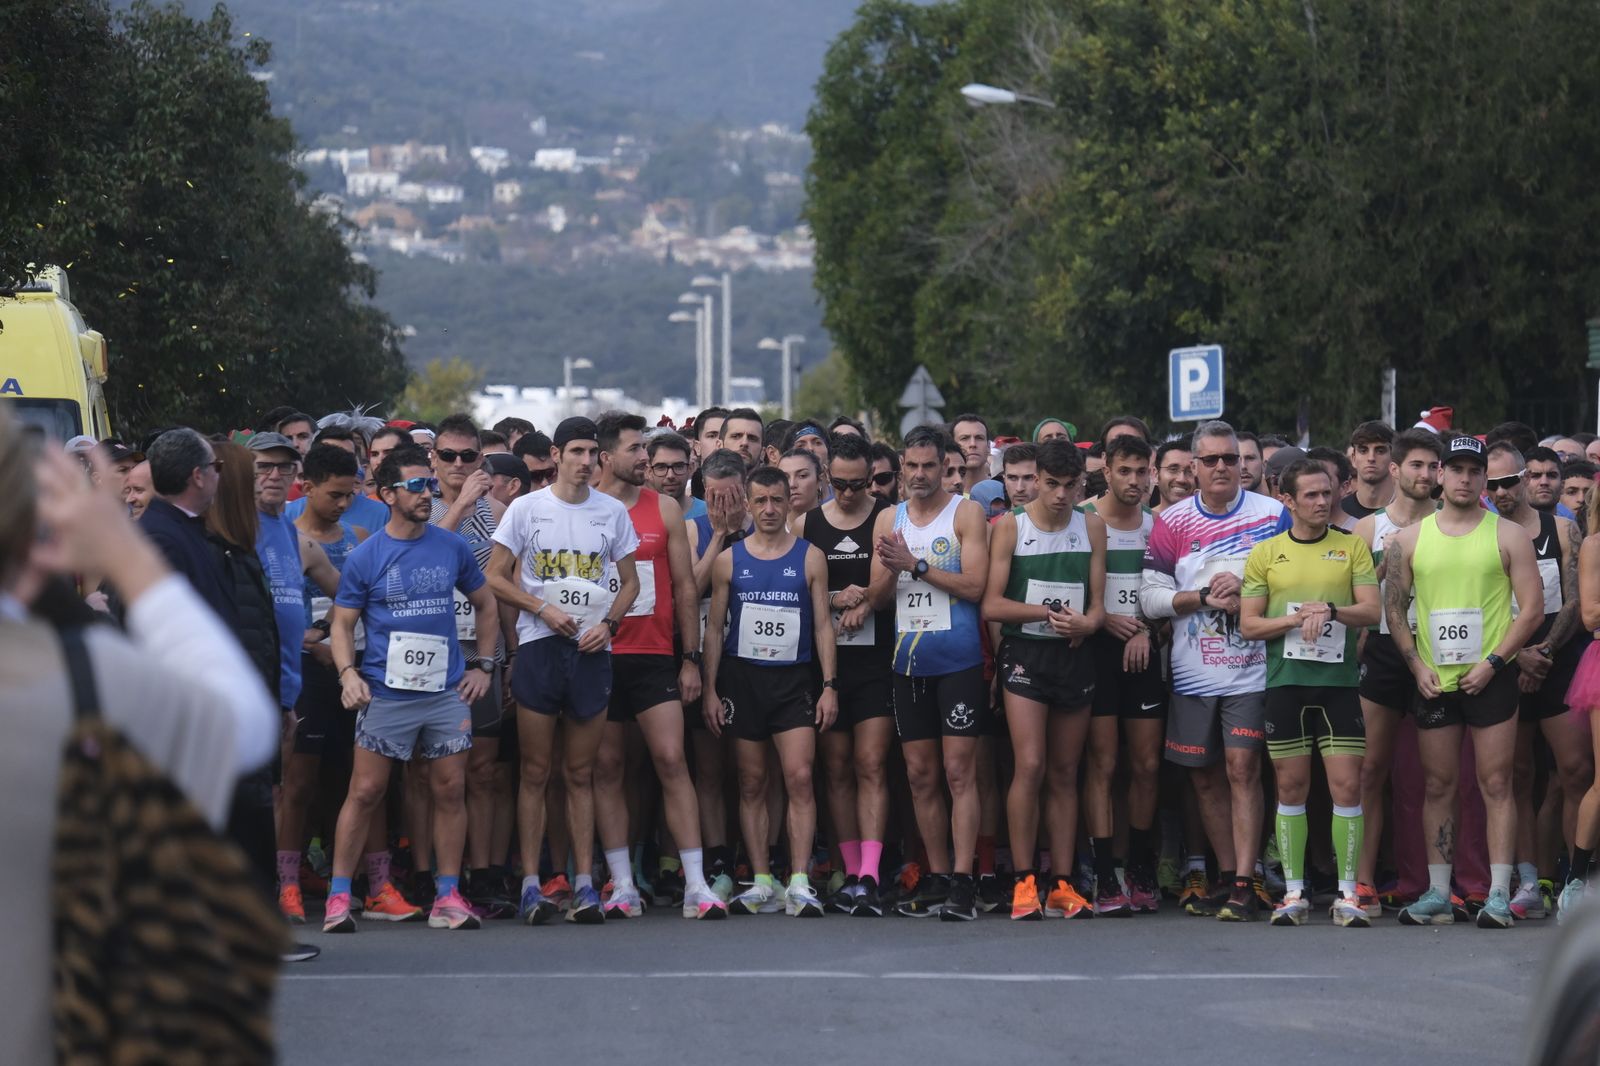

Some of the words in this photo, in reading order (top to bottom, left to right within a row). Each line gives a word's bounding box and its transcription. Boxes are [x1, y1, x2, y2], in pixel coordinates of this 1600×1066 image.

[1180, 358, 1209, 411] P
[387, 602, 407, 610] SAN
[407, 598, 449, 609] SILVESTRE
[560, 589, 591, 606] 361
[737, 591, 799, 602] TROTASIERRA
[907, 592, 932, 608] 271
[392, 606, 448, 618] CORDOBESA
[754, 620, 785, 637] 385
[1438, 624, 1468, 640] 266
[404, 649, 436, 667] 697
